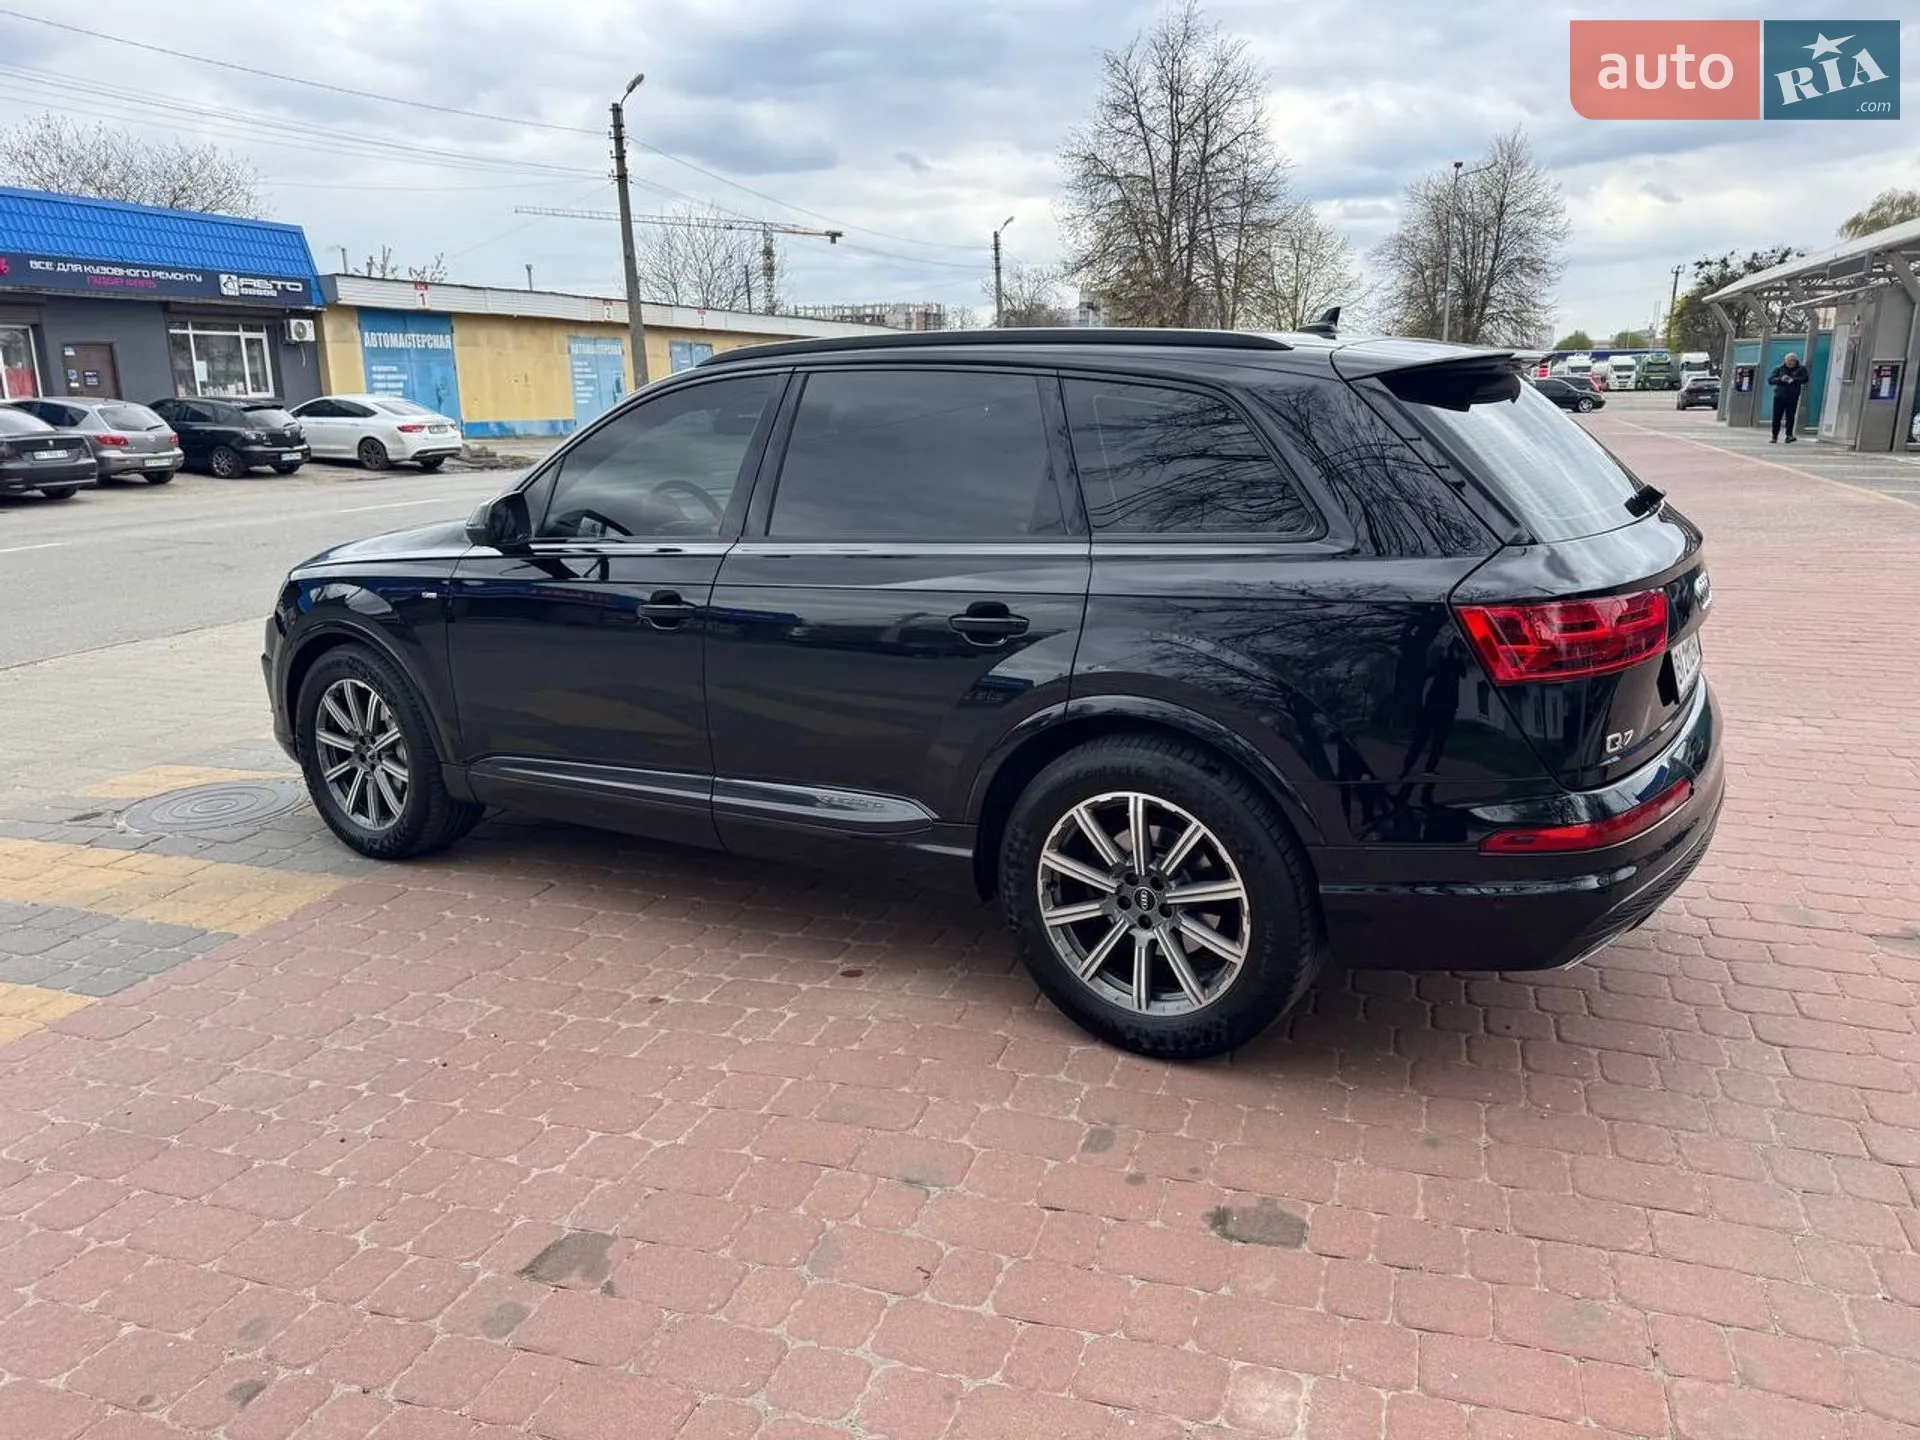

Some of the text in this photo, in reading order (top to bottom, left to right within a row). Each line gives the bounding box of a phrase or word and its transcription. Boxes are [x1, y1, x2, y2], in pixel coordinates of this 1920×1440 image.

[29, 260, 54, 271] ВСЕ
[56, 262, 83, 273] ДЛЯ
[152, 270, 202, 282] РЕМОНТУ
[418, 292, 427, 307] 1
[363, 331, 453, 350] АВТОМАСТЕРСКАЯ
[1606, 729, 1634, 753] Q7
